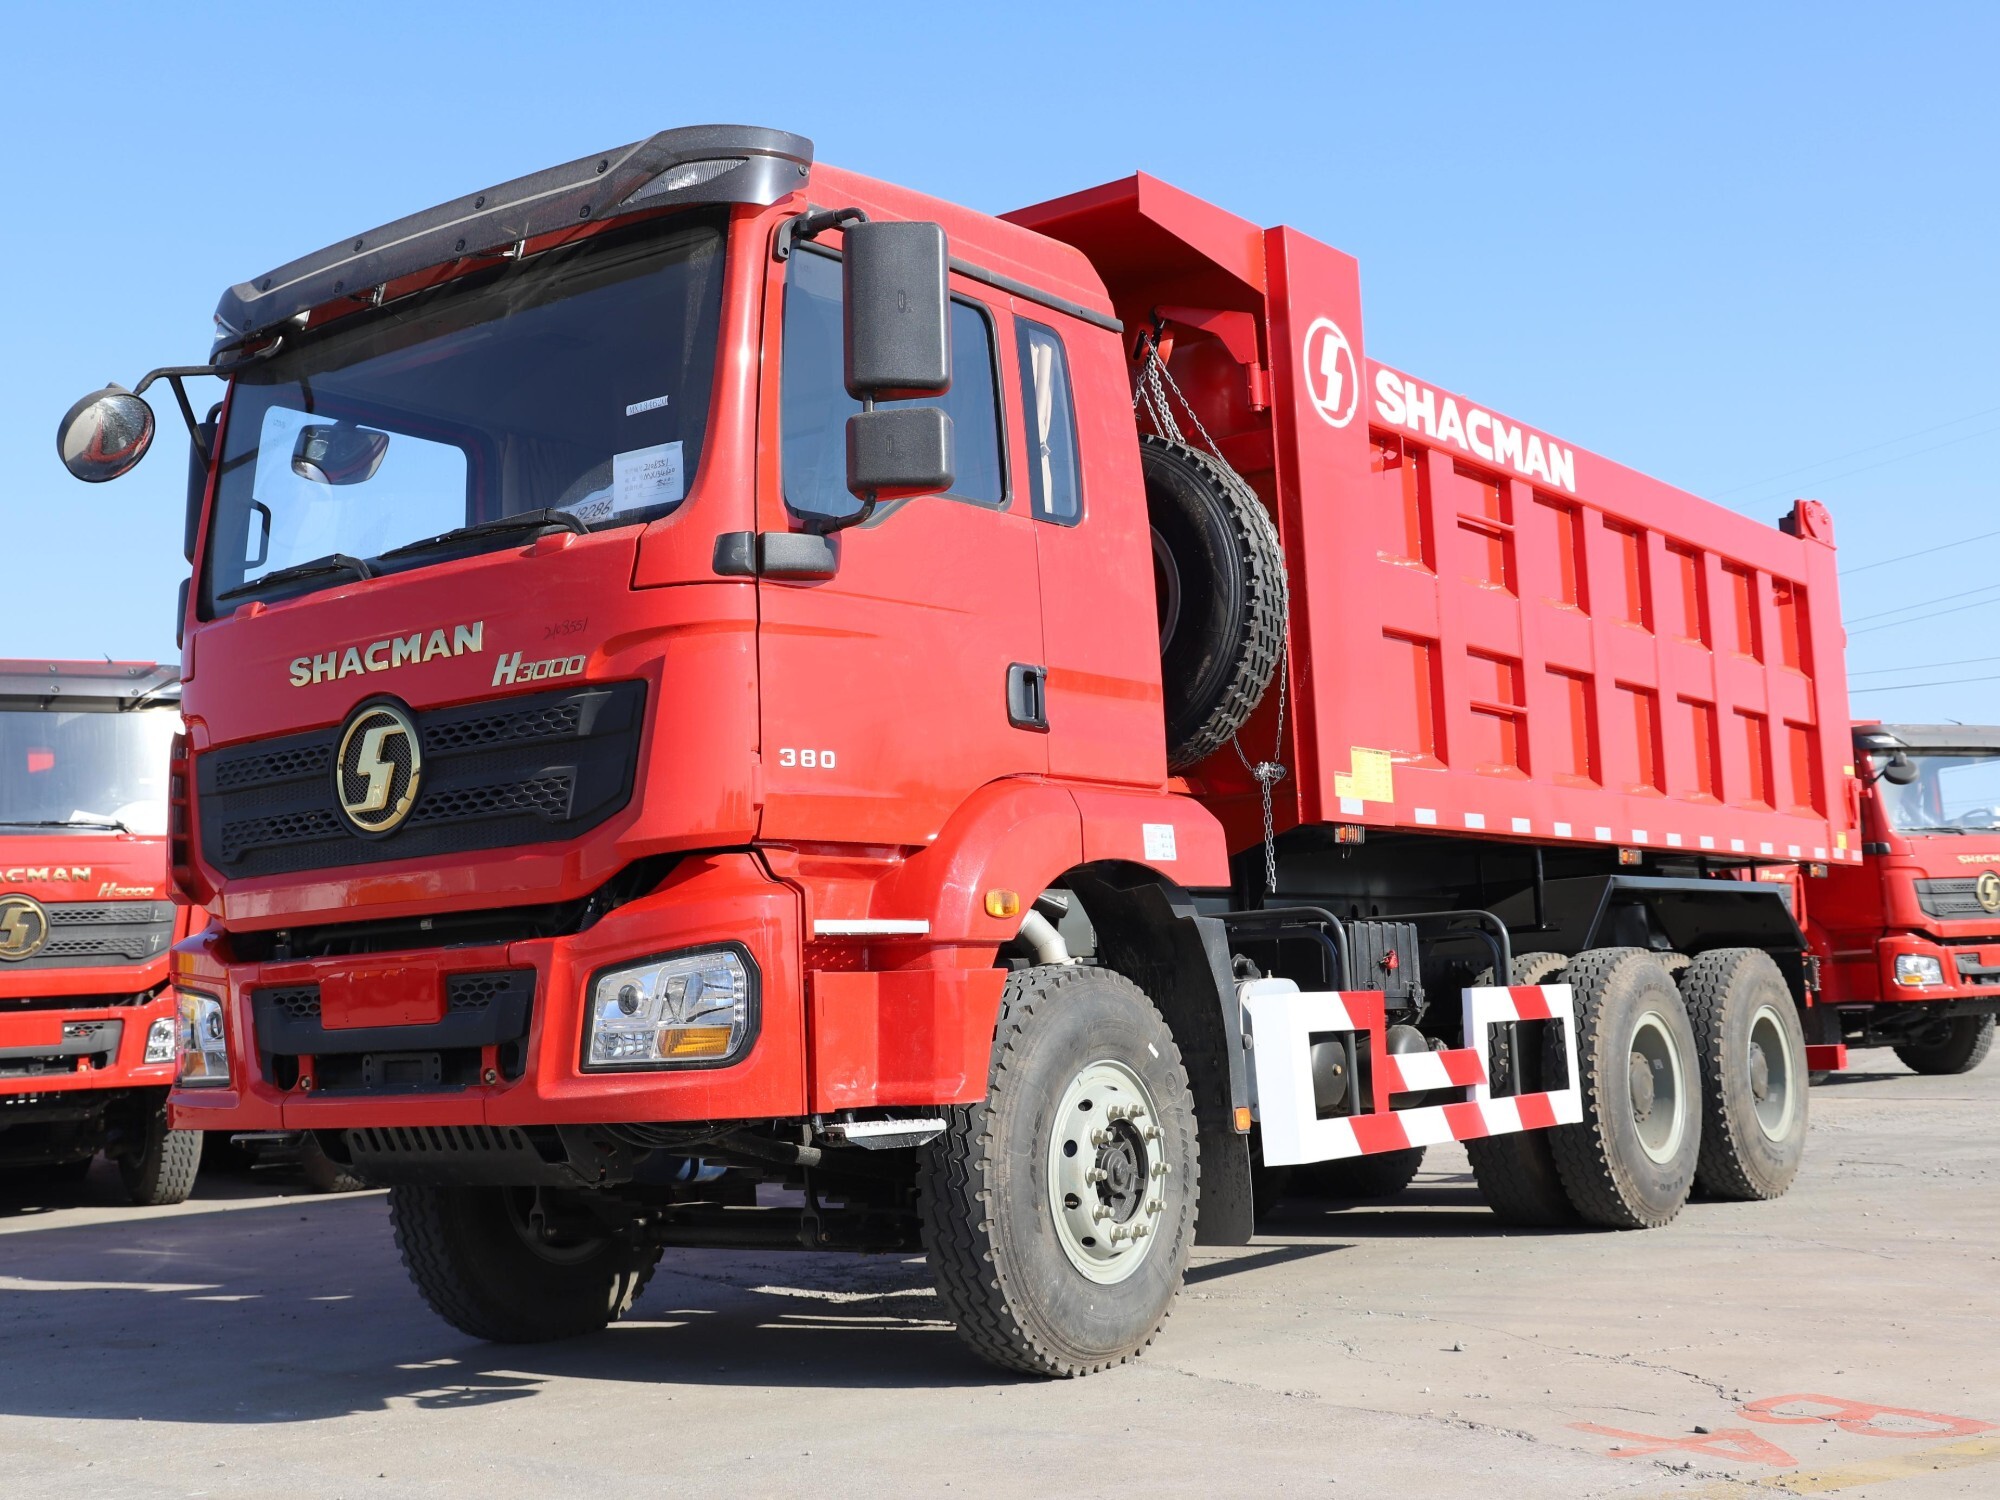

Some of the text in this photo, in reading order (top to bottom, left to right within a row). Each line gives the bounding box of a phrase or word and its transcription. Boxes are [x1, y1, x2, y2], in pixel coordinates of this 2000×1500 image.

[1375, 368, 1577, 493] SHACMAN
[289, 621, 484, 688] SHACMAN
[491, 650, 587, 687] H3000
[778, 748, 836, 769] 380
[97, 882, 155, 897] H3000
